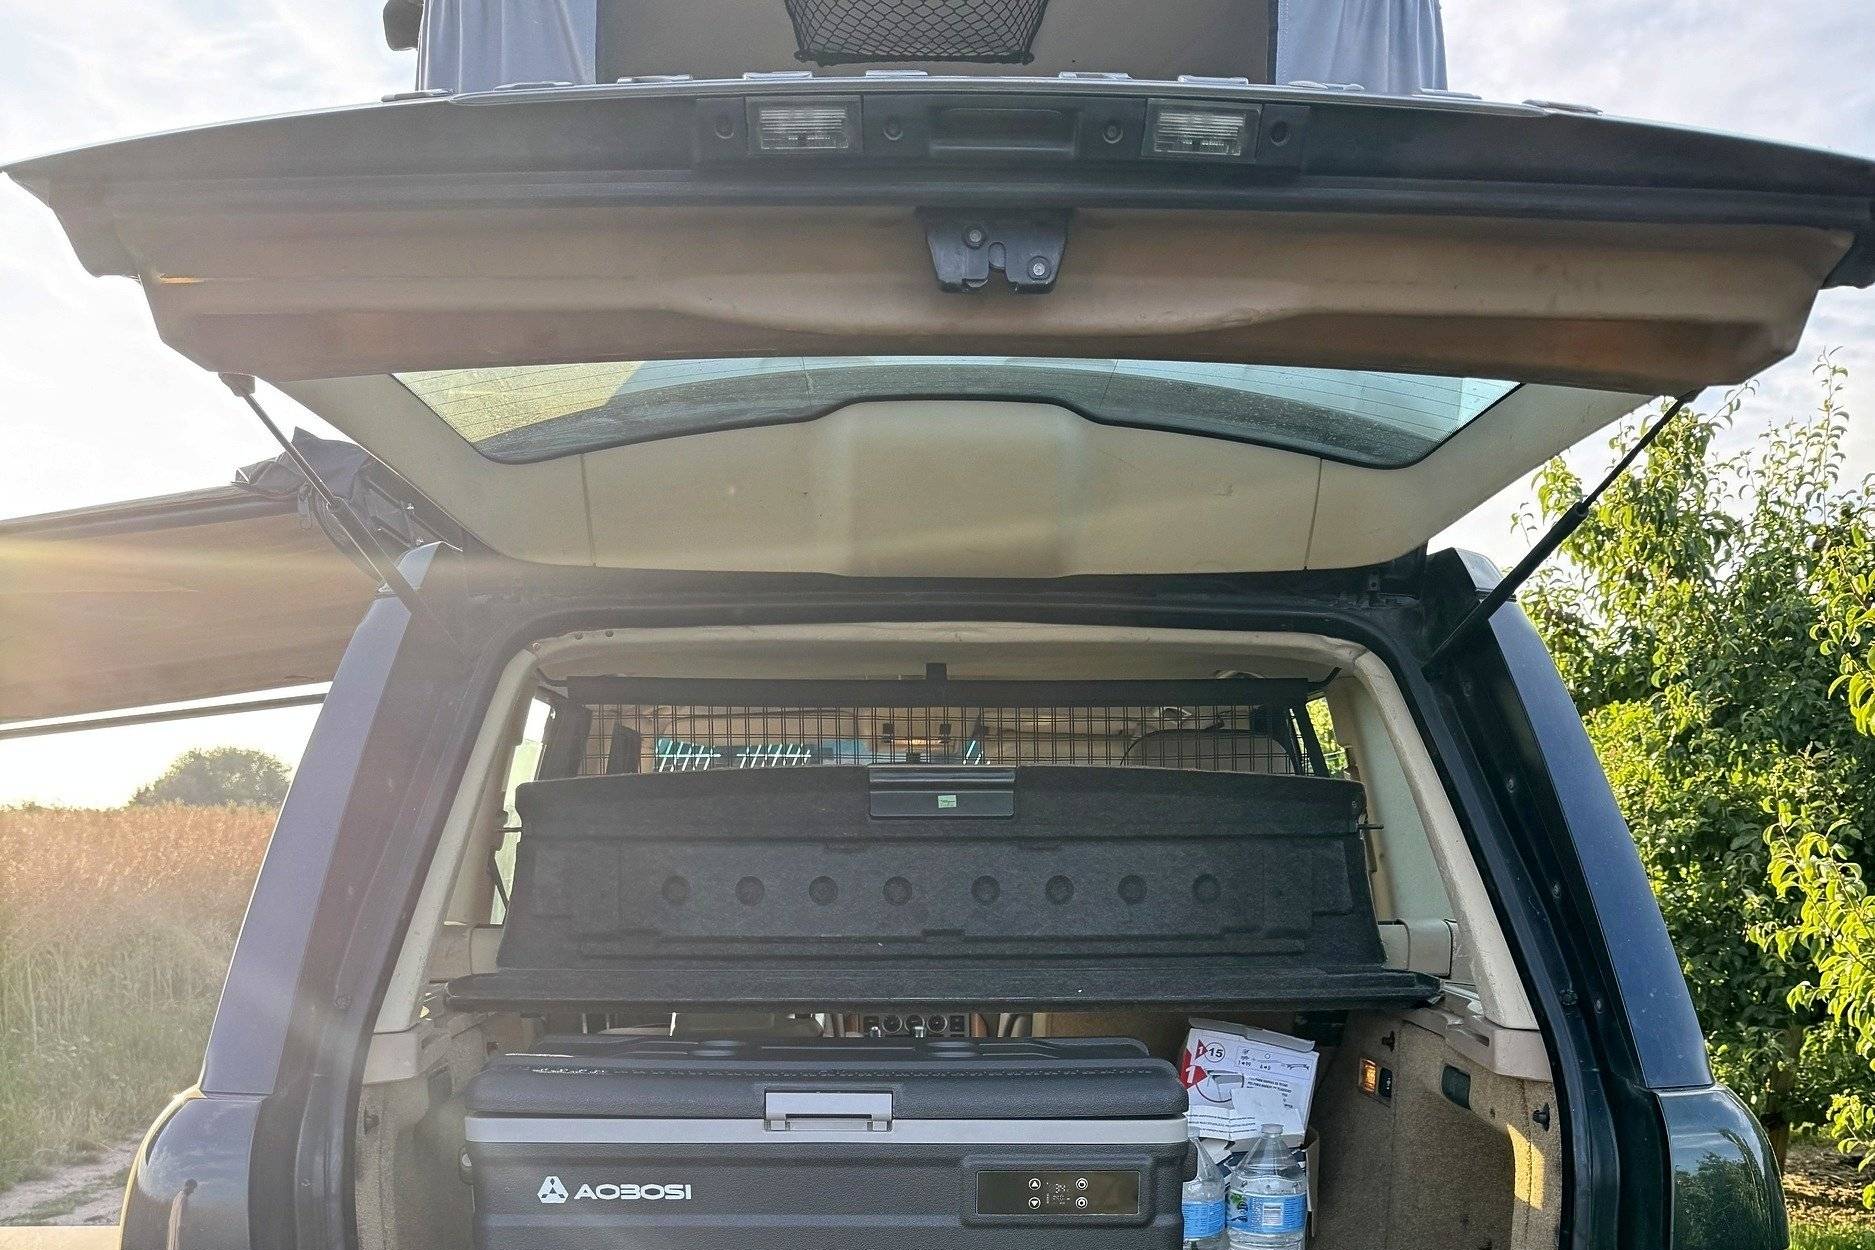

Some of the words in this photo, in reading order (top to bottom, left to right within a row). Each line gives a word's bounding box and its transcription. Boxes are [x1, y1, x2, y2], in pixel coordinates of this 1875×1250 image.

[1208, 1047, 1224, 1058] 15
[1185, 1065, 1196, 1084] 1
[573, 1183, 692, 1200] AOBOSI
